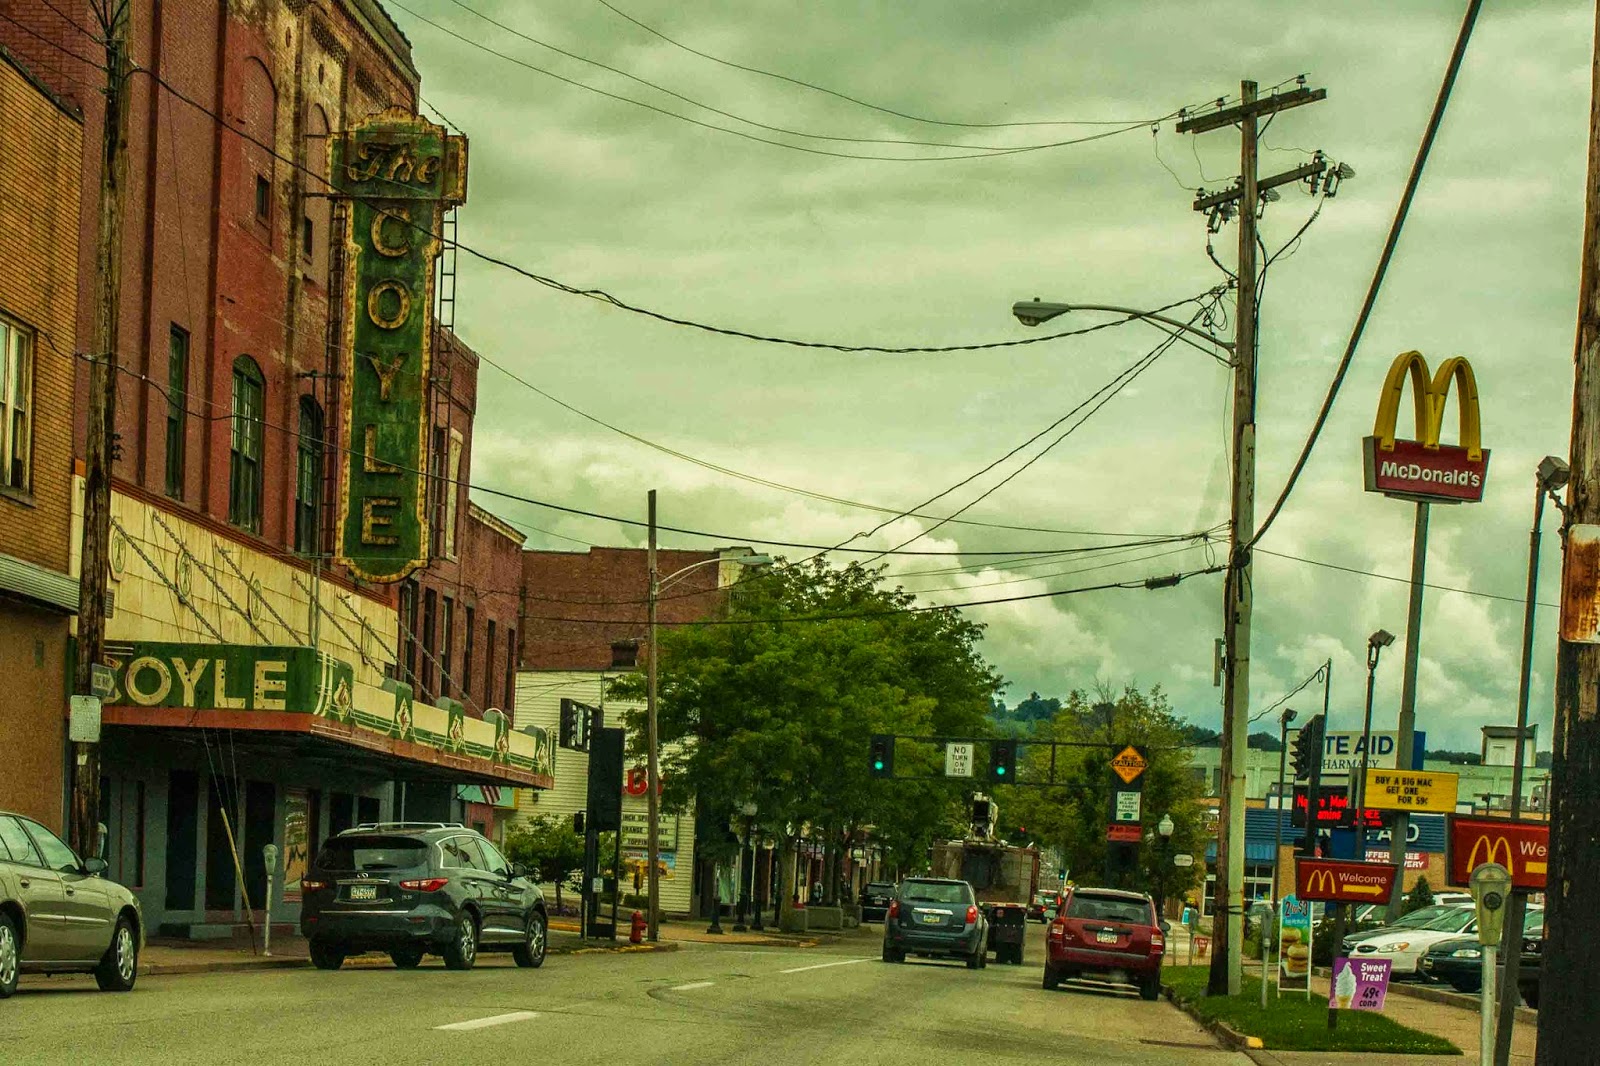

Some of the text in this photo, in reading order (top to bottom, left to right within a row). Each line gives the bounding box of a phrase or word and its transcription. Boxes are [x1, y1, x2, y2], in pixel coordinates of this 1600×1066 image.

[347, 142, 441, 184] The
[361, 206, 412, 546] COYLE
[1380, 460, 1481, 487] McDonald's
[953, 746, 966, 754] NO
[1325, 735, 1394, 755] TE AID
[1322, 758, 1380, 770] HARMAY
[1375, 776, 1433, 787] BUY A BIG MAC
[1386, 786, 1419, 795] GET ONE
[1397, 796, 1412, 804] FOR
[1519, 841, 1547, 856] We
[1404, 852, 1420, 860] REE
[1338, 872, 1387, 884] Welcome
[1285, 901, 1291, 917] 2
[1360, 962, 1387, 973] Sweet
[1361, 973, 1384, 982] Treat
